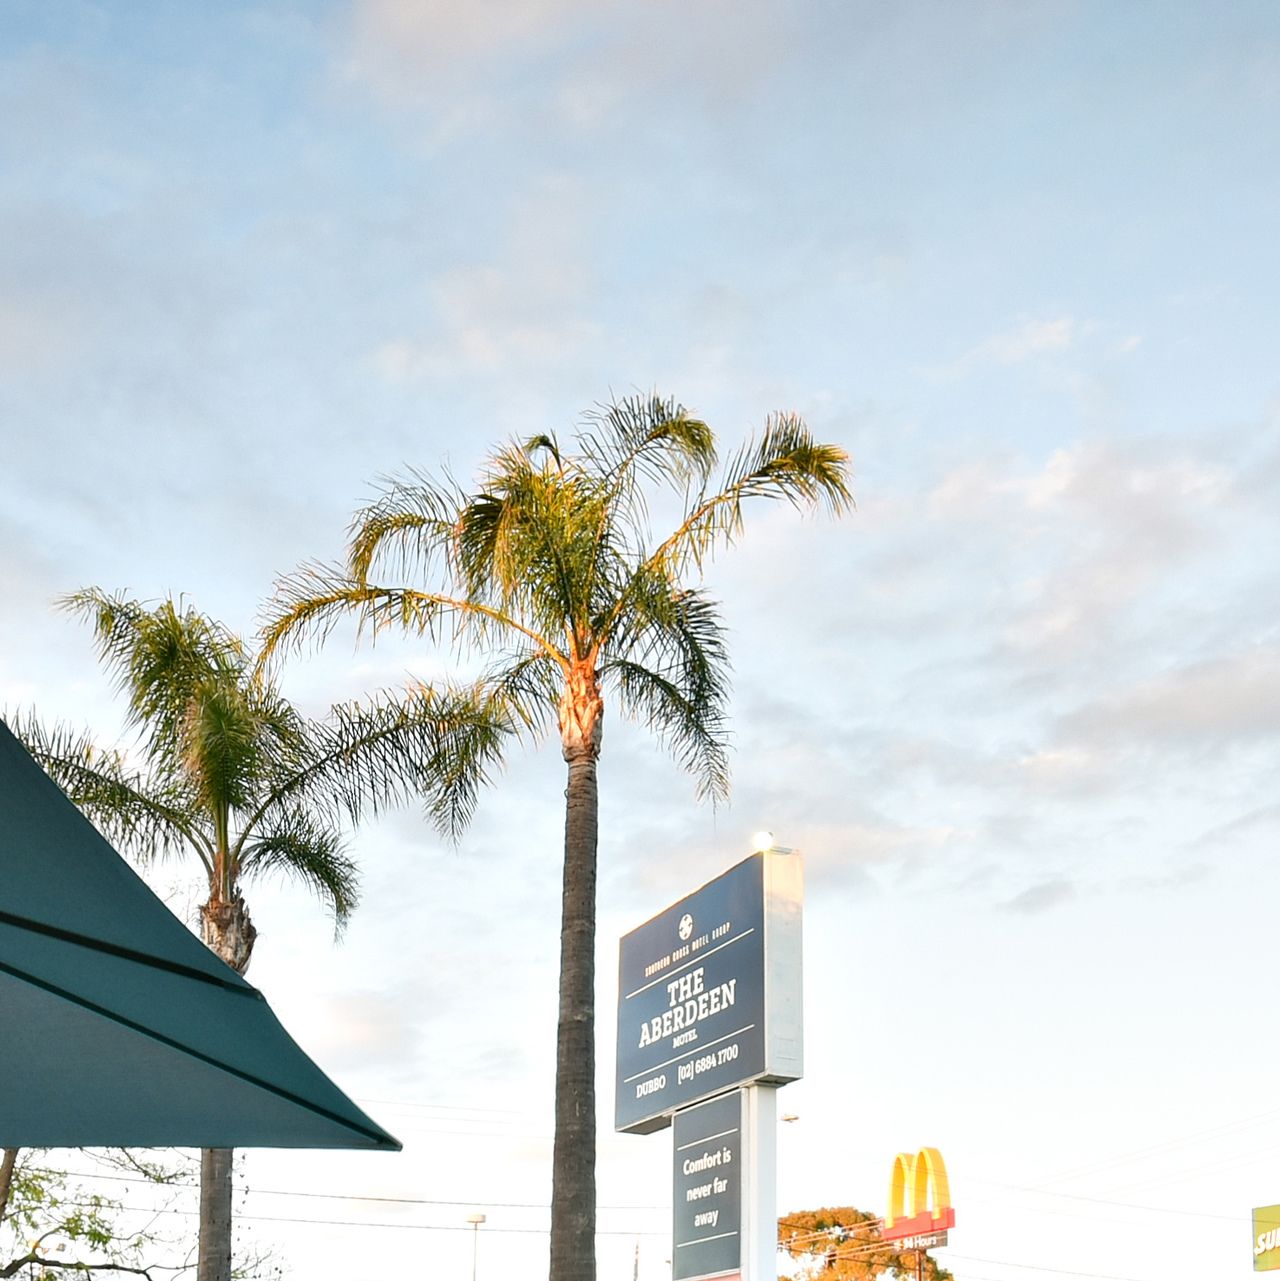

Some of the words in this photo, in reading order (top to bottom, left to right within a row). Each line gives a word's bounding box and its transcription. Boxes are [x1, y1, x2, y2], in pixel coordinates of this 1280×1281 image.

[672, 944, 690, 962] CROSS
[712, 921, 731, 940] GROUP
[667, 967, 704, 1007] THE
[639, 979, 737, 1048] ABERDEEN
[672, 1028, 698, 1049] MOTEL
[636, 1074, 667, 1098] DUBBO
[695, 1053, 716, 1074] 6884
[717, 1044, 739, 1065] 1700
[683, 1150, 722, 1175] Comfort
[723, 1146, 732, 1164] is
[686, 1183, 713, 1202] never
[713, 1176, 728, 1194] far
[694, 1209, 719, 1227] away
[914, 1235, 937, 1249] Hours
